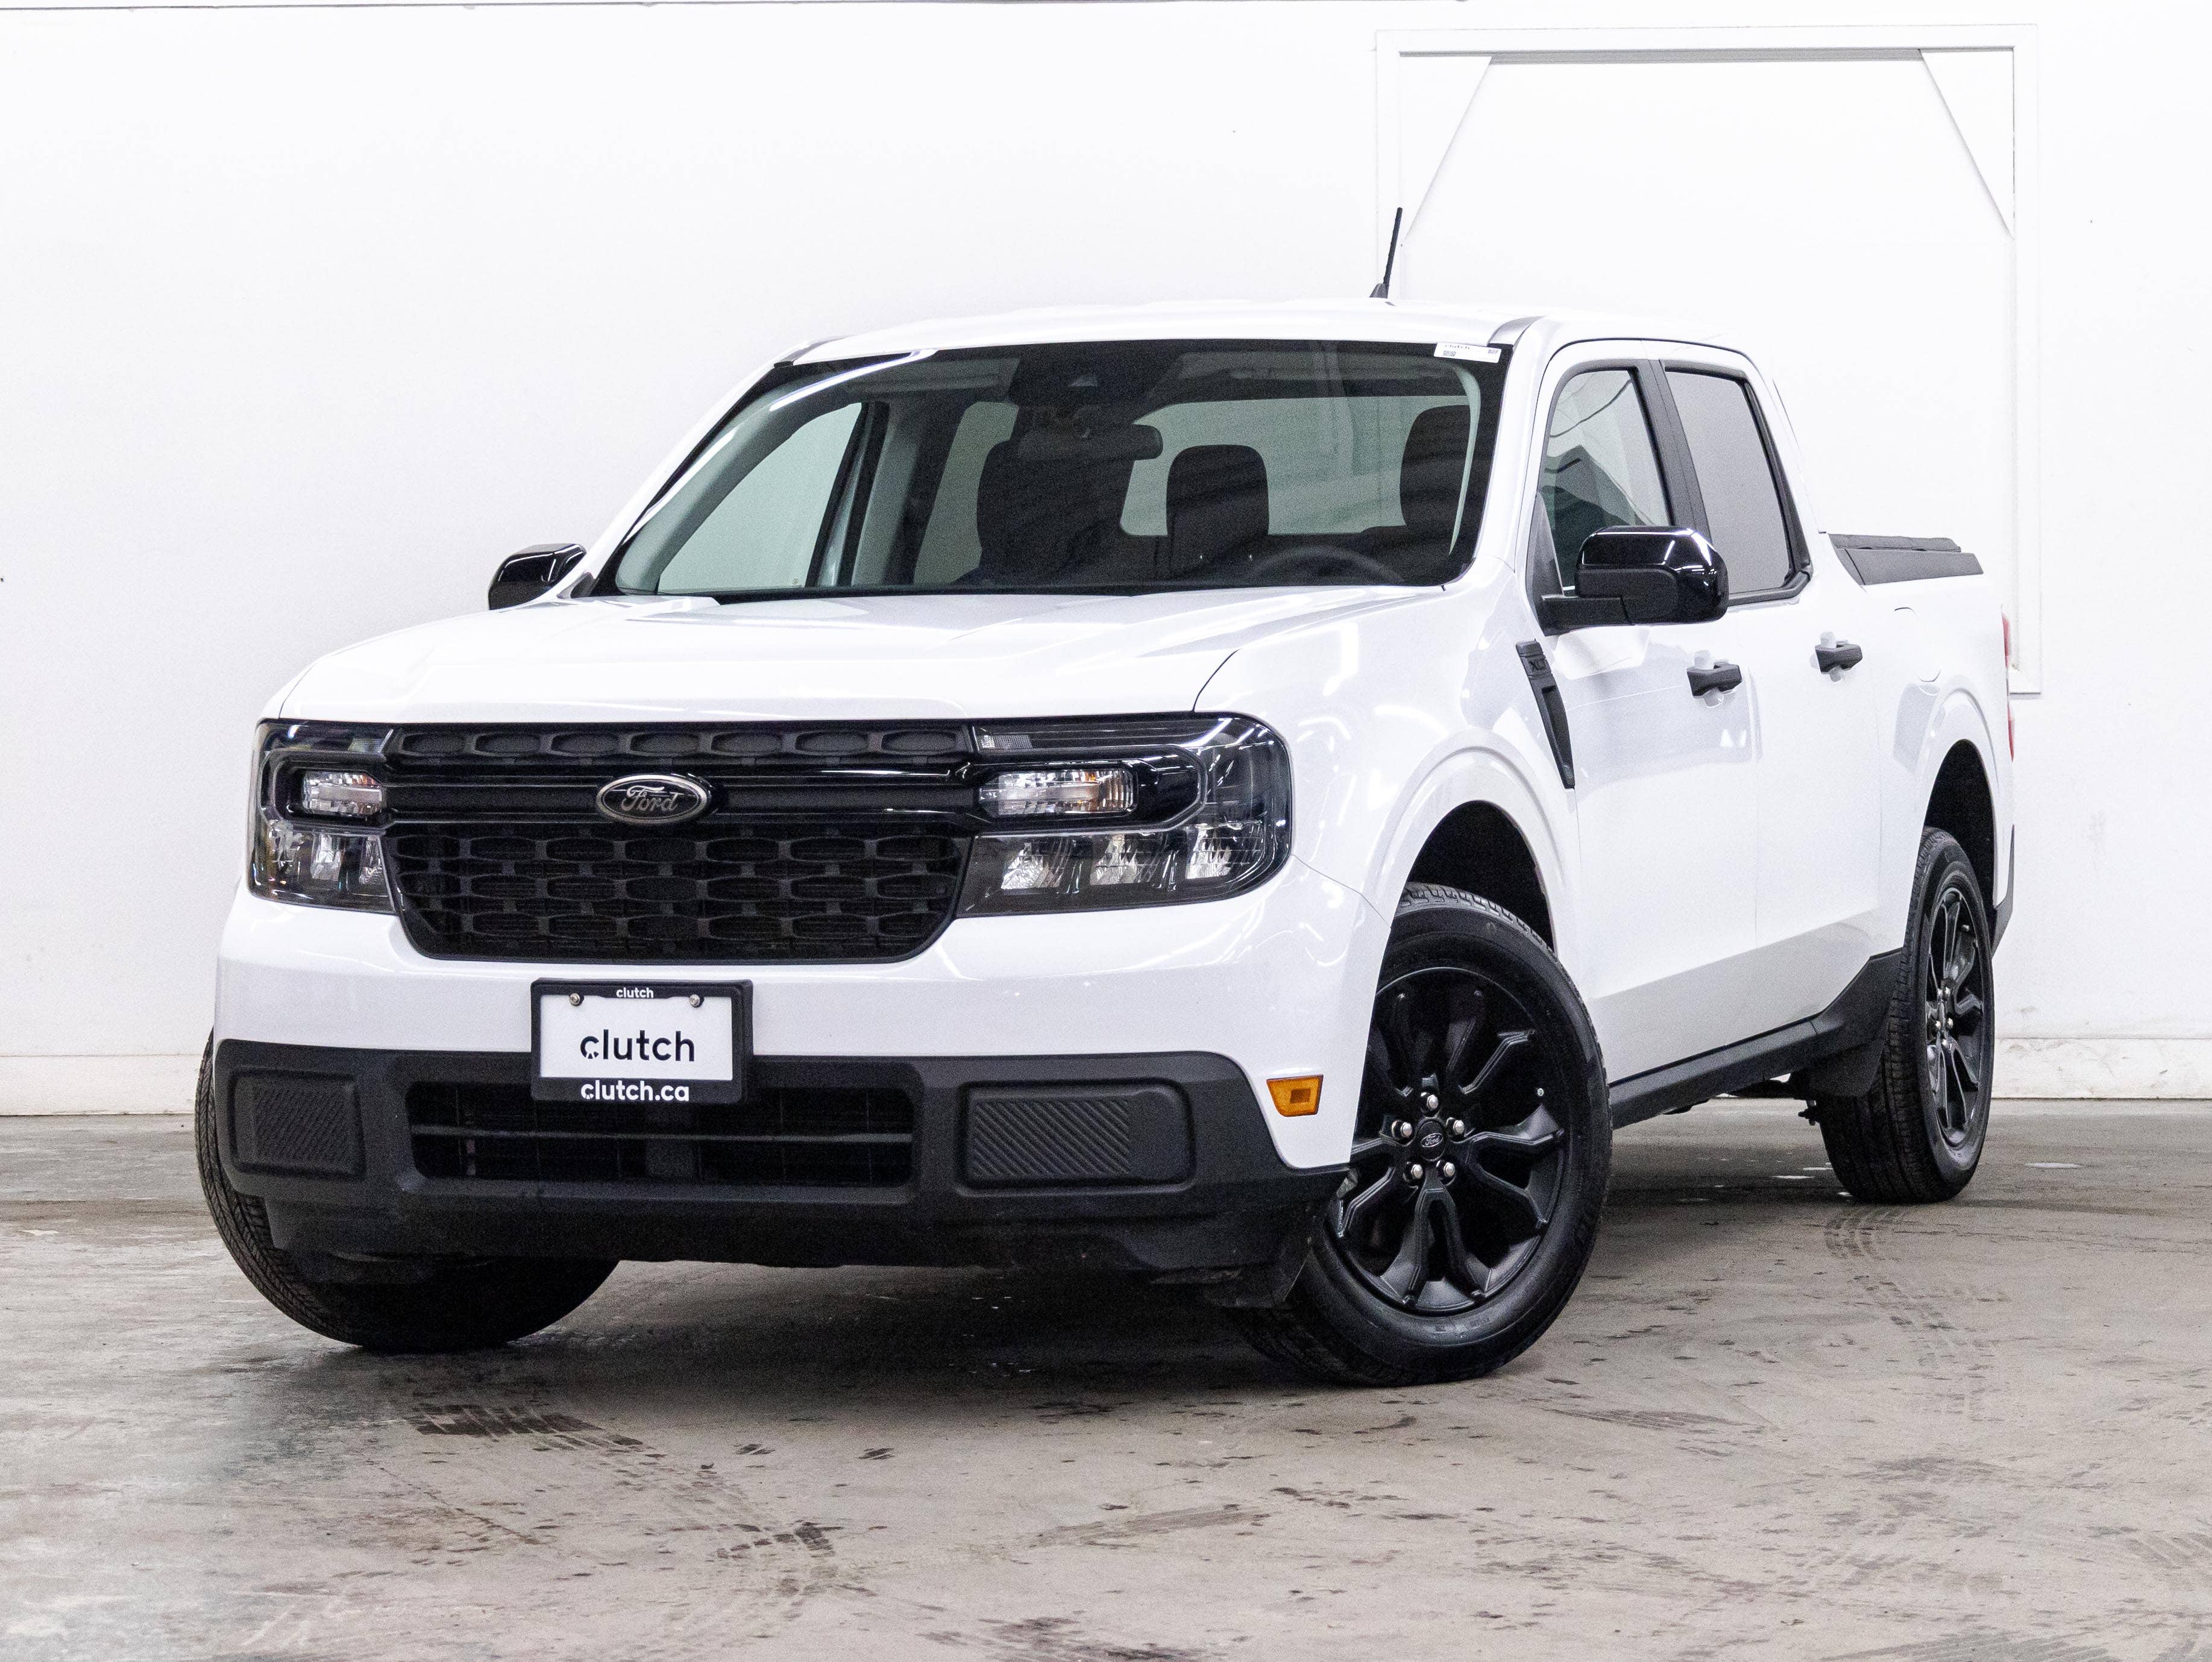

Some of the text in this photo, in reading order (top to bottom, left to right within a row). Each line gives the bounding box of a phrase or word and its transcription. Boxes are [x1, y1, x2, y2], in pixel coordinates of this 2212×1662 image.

[621, 785, 680, 812] Ford
[616, 987, 654, 999] clutch
[580, 1029, 694, 1062] clutch
[580, 1080, 690, 1102] clutch.ca
[1425, 1135, 1440, 1146] Ford
